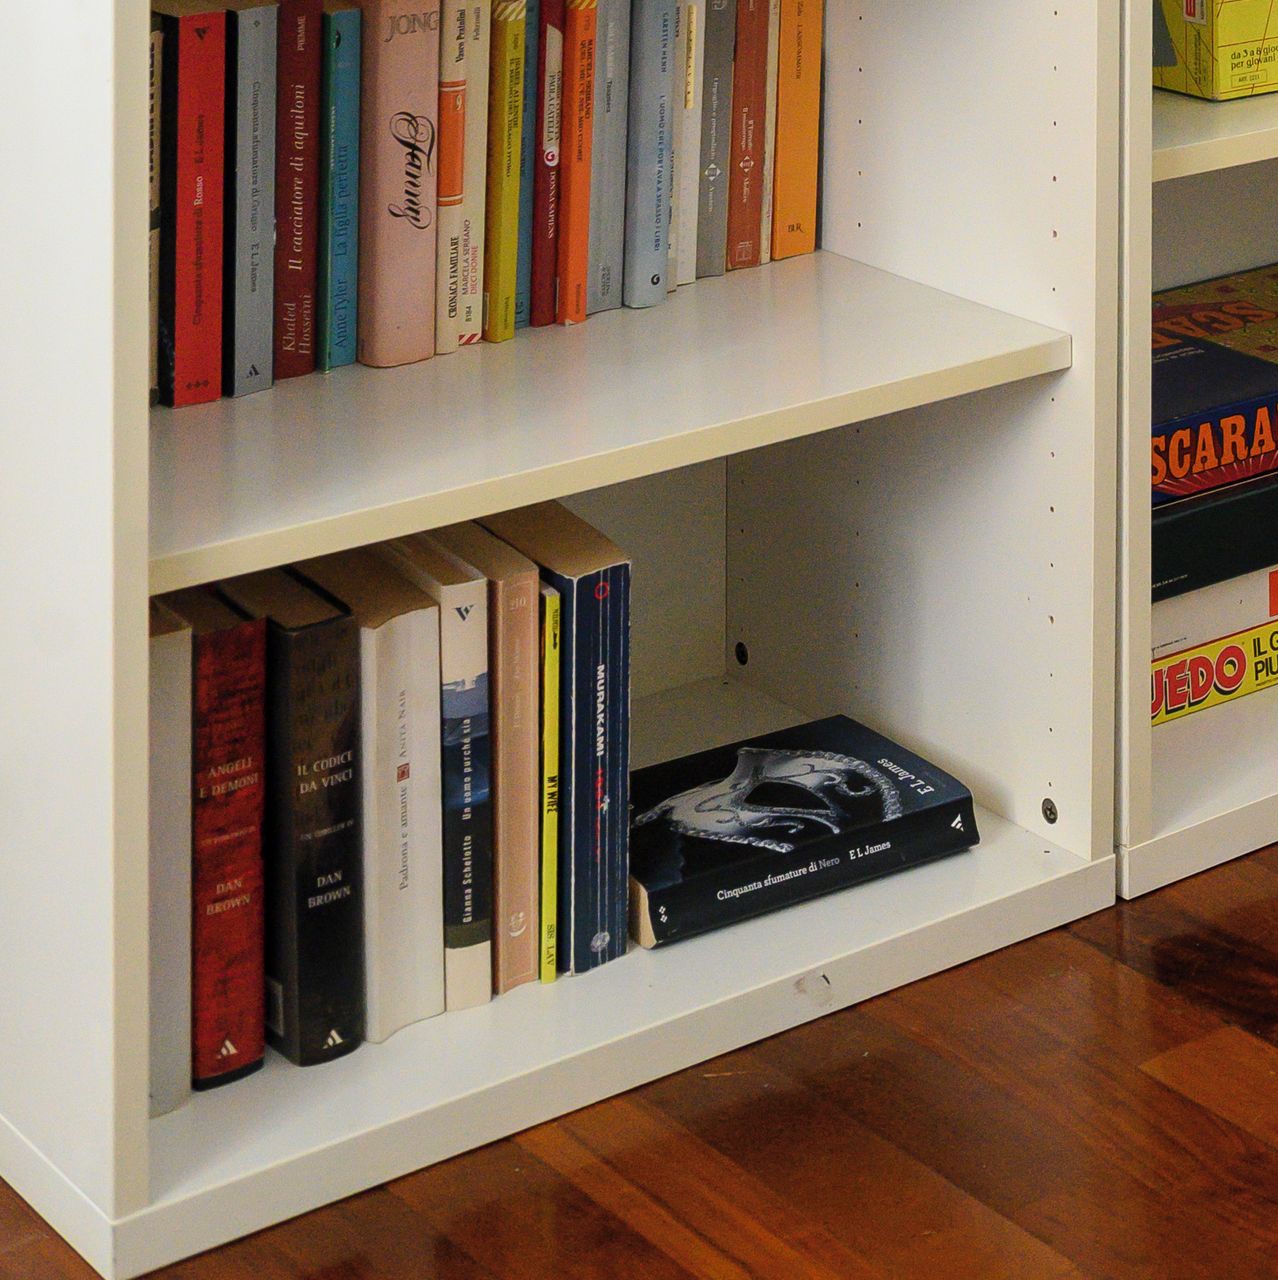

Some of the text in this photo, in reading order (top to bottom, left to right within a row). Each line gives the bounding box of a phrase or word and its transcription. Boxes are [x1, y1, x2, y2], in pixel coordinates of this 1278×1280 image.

[297, 16, 306, 51] PIEMME
[385, 10, 440, 42] JONG
[456, 9, 466, 63] Vasco Pratolini
[1231, 50, 1241, 60] da
[1243, 49, 1248, 58] 3
[1249, 49, 1255, 57] a
[1231, 60, 1244, 71] per
[1246, 52, 1276, 69] giovani
[194, 175, 204, 206] Rosso
[288, 84, 308, 271] Il cacciatore di aquiloni
[335, 203, 349, 236] figlia
[548, 201, 556, 239] SAPIENS
[335, 239, 348, 257] La
[471, 244, 479, 273] DONNE
[448, 236, 459, 319] CRONACA FAMILIARE
[462, 258, 470, 295] MARCELA
[335, 279, 350, 313] Tyler
[282, 302, 297, 352] Khaled
[299, 293, 312, 354] Hosseini
[334, 313, 348, 349] Anne
[1253, 637, 1267, 657] IL
[461, 718, 471, 734] sia
[596, 664, 605, 757] MURAKAMI
[207, 756, 252, 779] ANGELI
[297, 764, 309, 777] IL
[300, 769, 353, 794] DA VINCI
[547, 775, 557, 790] MY
[877, 758, 916, 786] James
[199, 773, 259, 799] E DEMONI
[463, 777, 472, 803] uomo
[400, 786, 409, 829] amante
[462, 807, 472, 820] Un
[399, 842, 409, 891] Padrona
[462, 835, 472, 885] Schelotto
[716, 840, 891, 901] Cinquanta sfumature di Nero E L James
[216, 878, 242, 895] DAN
[317, 870, 344, 889] DAN
[206, 893, 250, 916] BROWN
[307, 885, 351, 909] BROWN
[462, 888, 472, 923] Gianna
